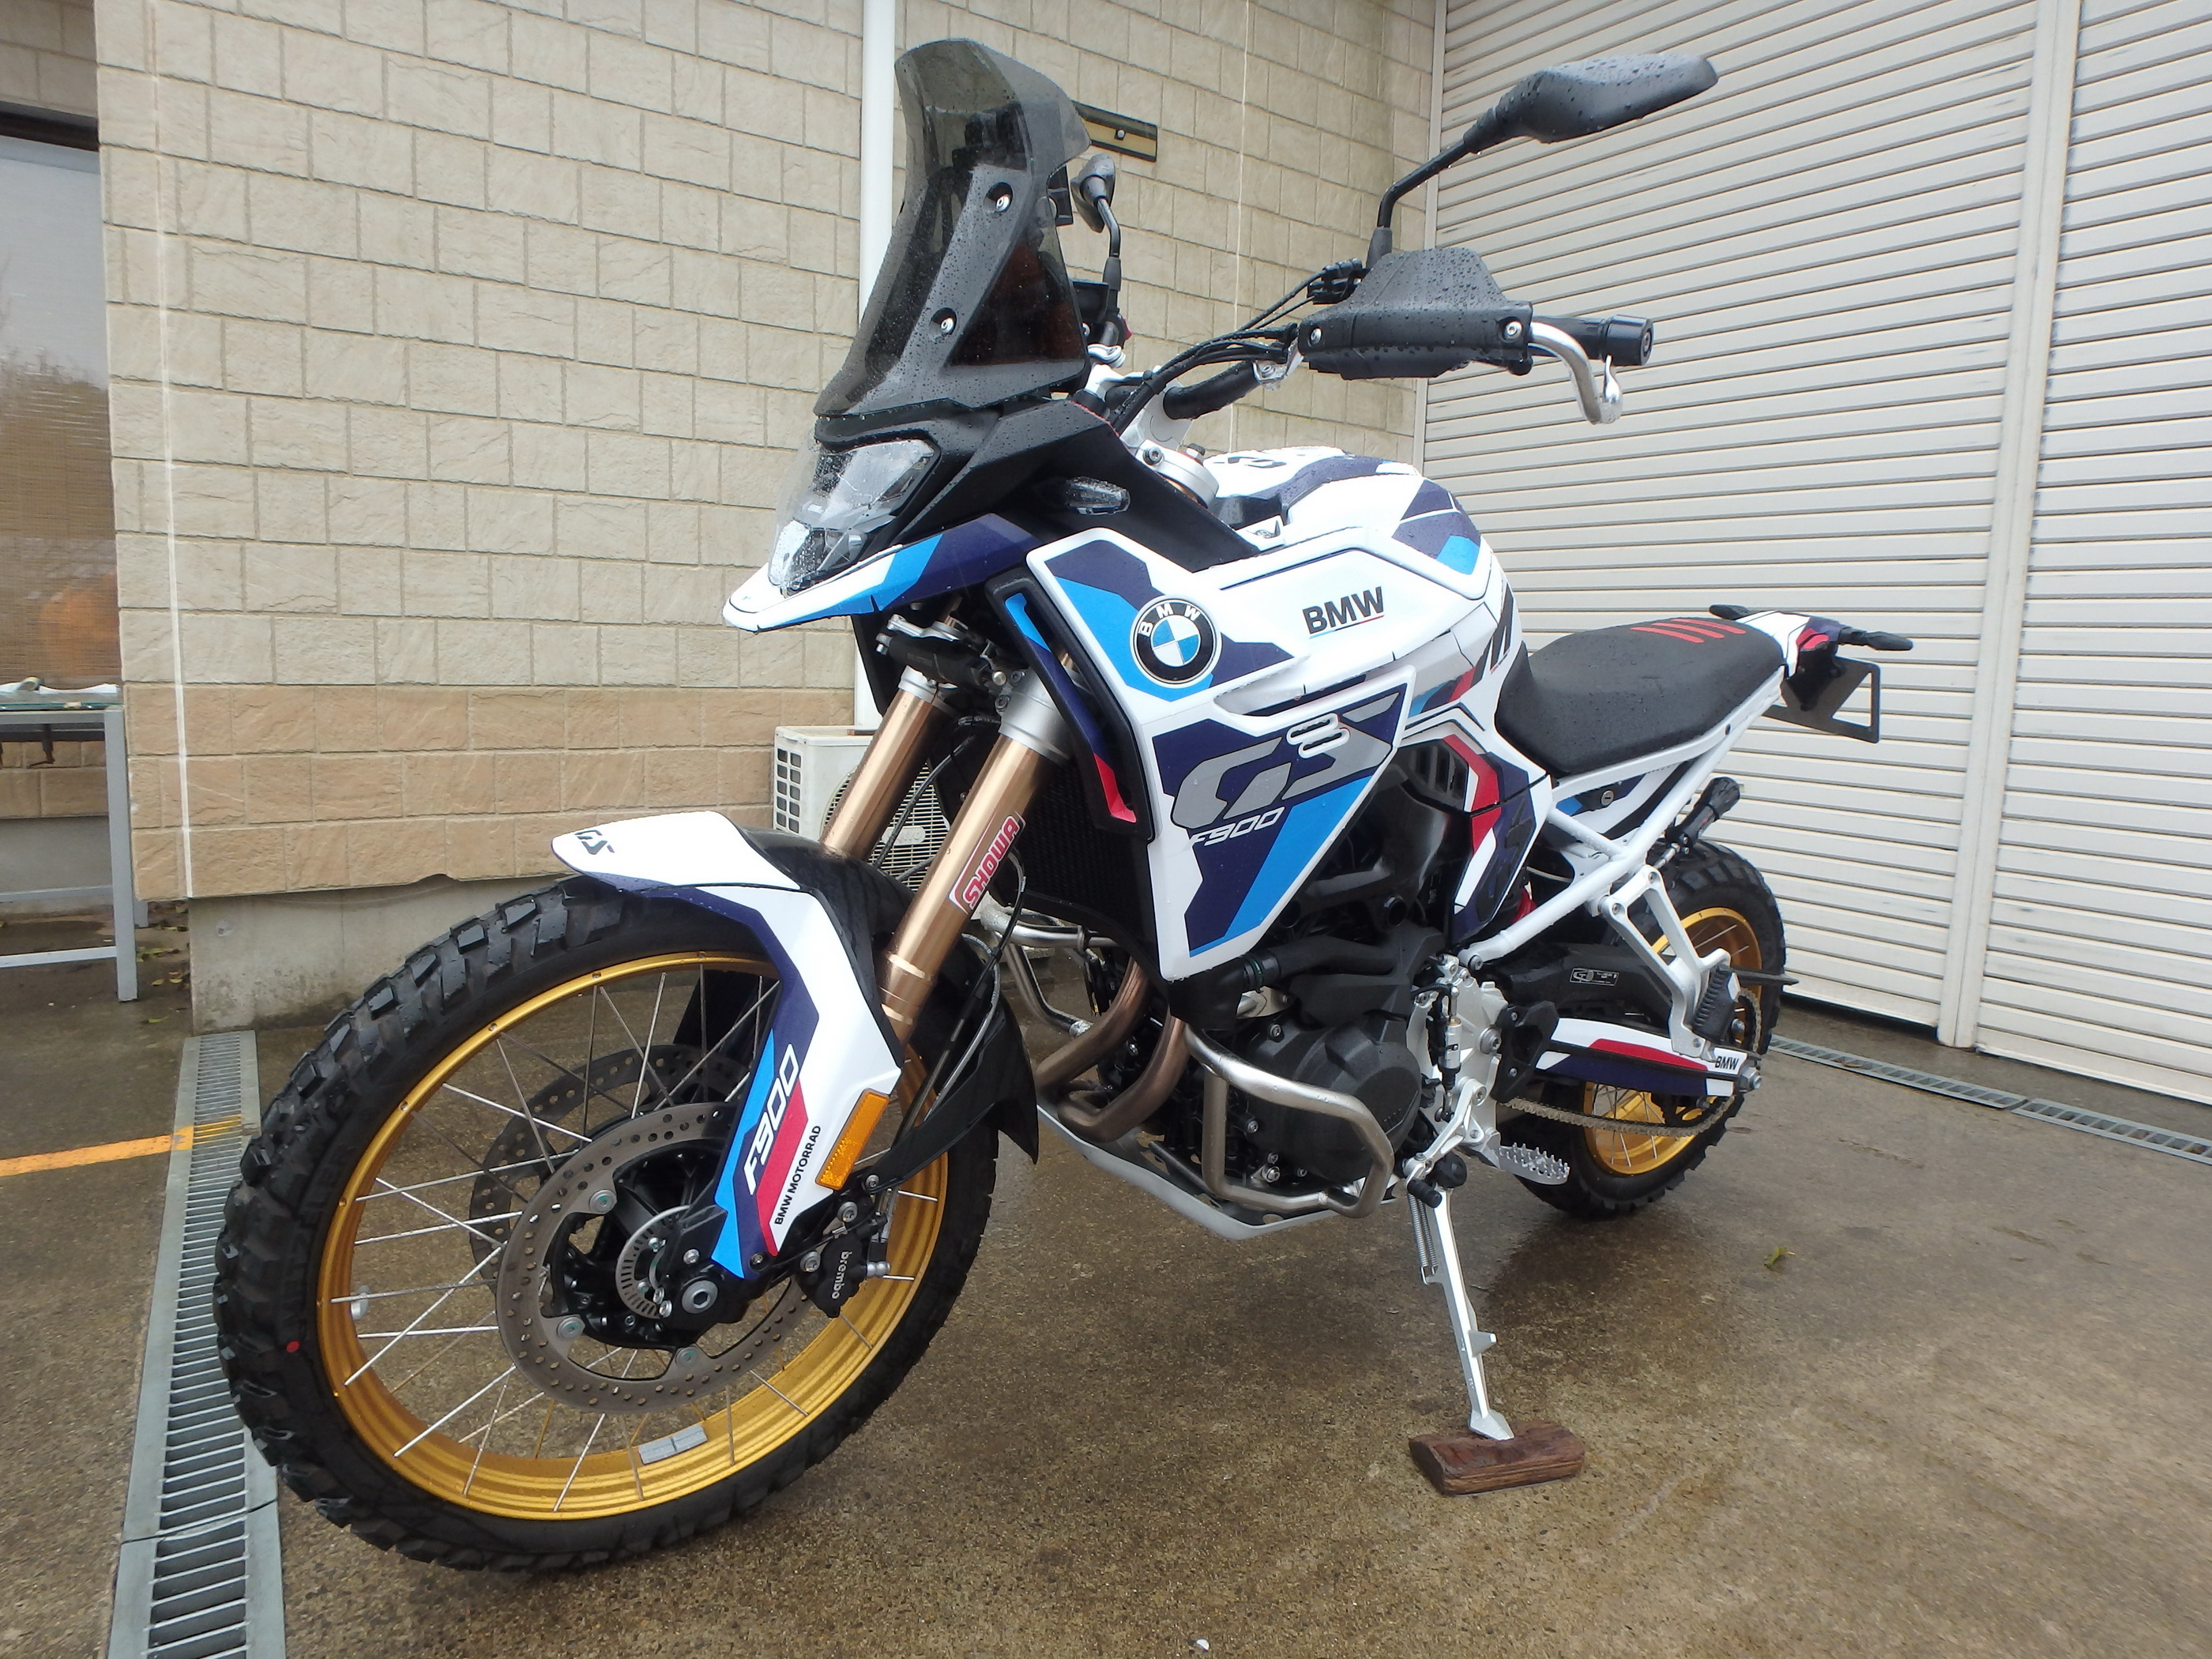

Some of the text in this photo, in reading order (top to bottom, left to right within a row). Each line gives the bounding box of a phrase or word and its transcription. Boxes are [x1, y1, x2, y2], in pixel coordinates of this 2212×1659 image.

[1138, 603, 1201, 637] BMW
[1302, 585, 1384, 634] BMW
[1188, 806, 1285, 847] F900
[964, 817, 1019, 909] SHOWA
[1715, 1055, 1740, 1070] BMW
[743, 1043, 799, 1195] F900
[774, 1124, 822, 1225] BMW MOTORRAD
[832, 1251, 852, 1300] brembo
